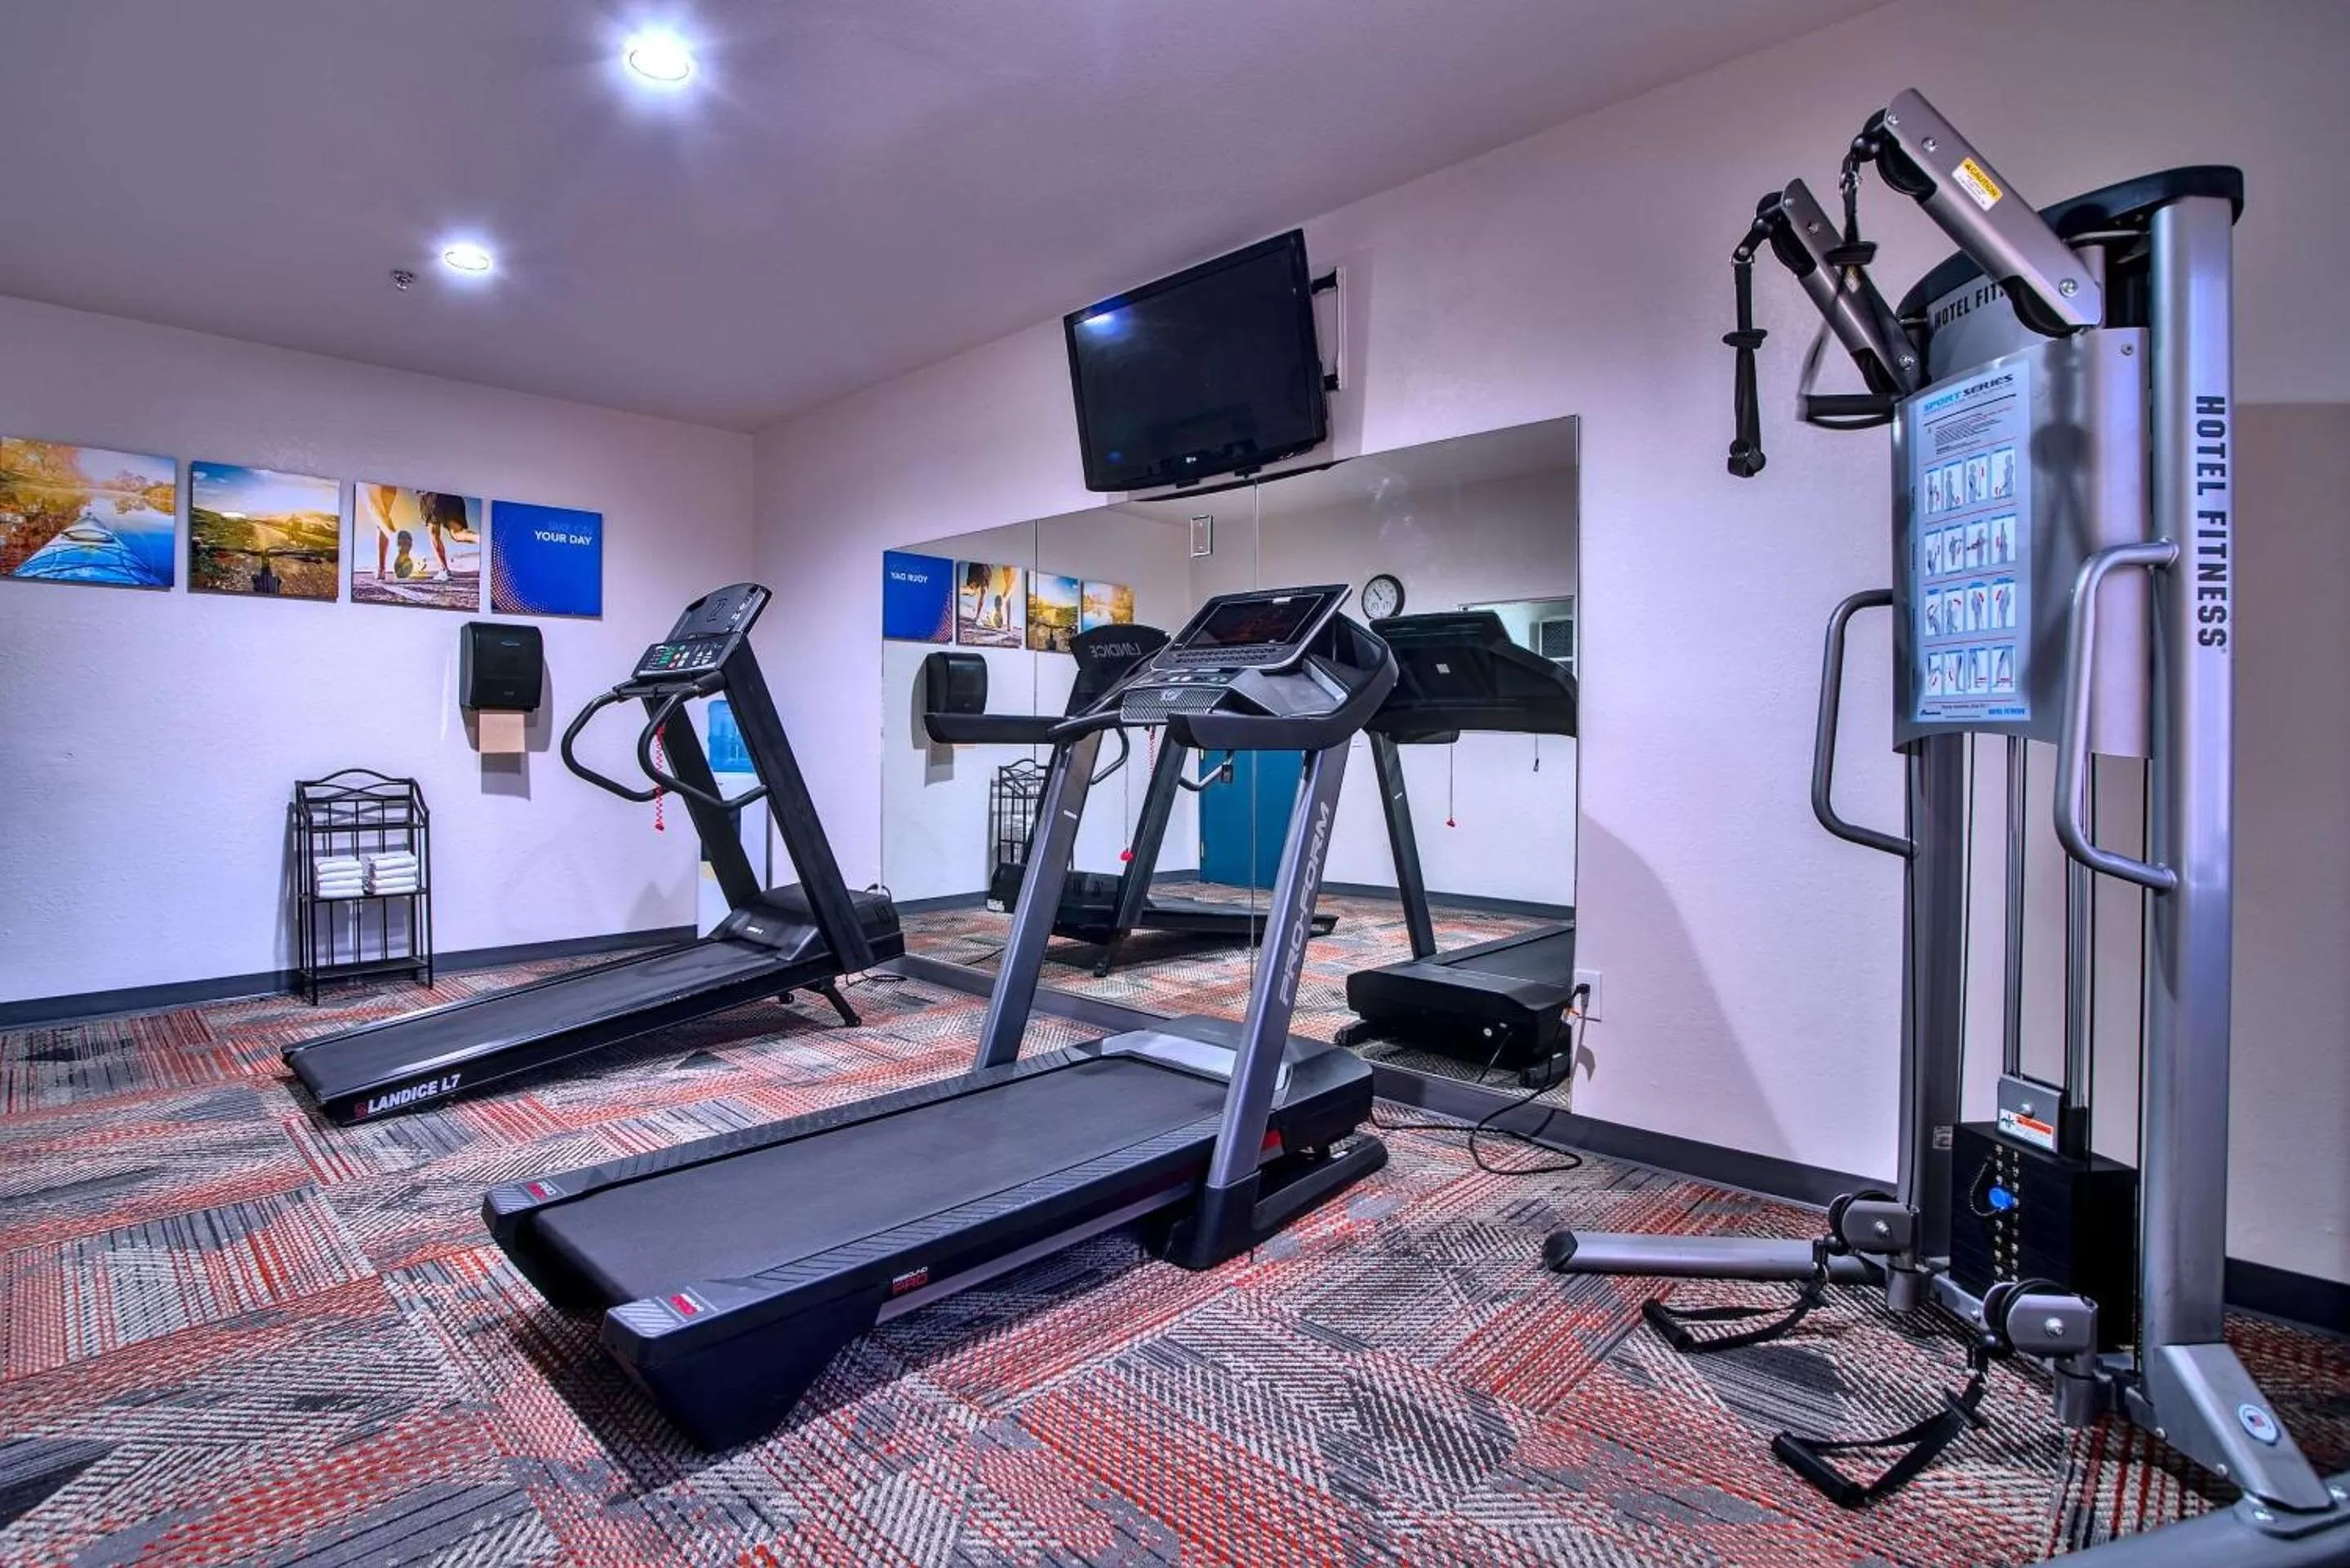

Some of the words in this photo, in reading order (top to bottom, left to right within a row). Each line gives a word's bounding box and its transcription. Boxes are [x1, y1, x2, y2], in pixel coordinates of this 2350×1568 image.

[1969, 166, 1998, 198] CAUTION
[1934, 295, 1970, 331] HOTEL
[1975, 282, 2004, 309] FIT
[2196, 396, 2226, 495] HOTEL
[535, 530, 566, 543] YOUR
[570, 535, 593, 546] DAY
[2197, 510, 2227, 646] FITNESS
[368, 1080, 438, 1114] LANDICE
[442, 1073, 461, 1091] L7
